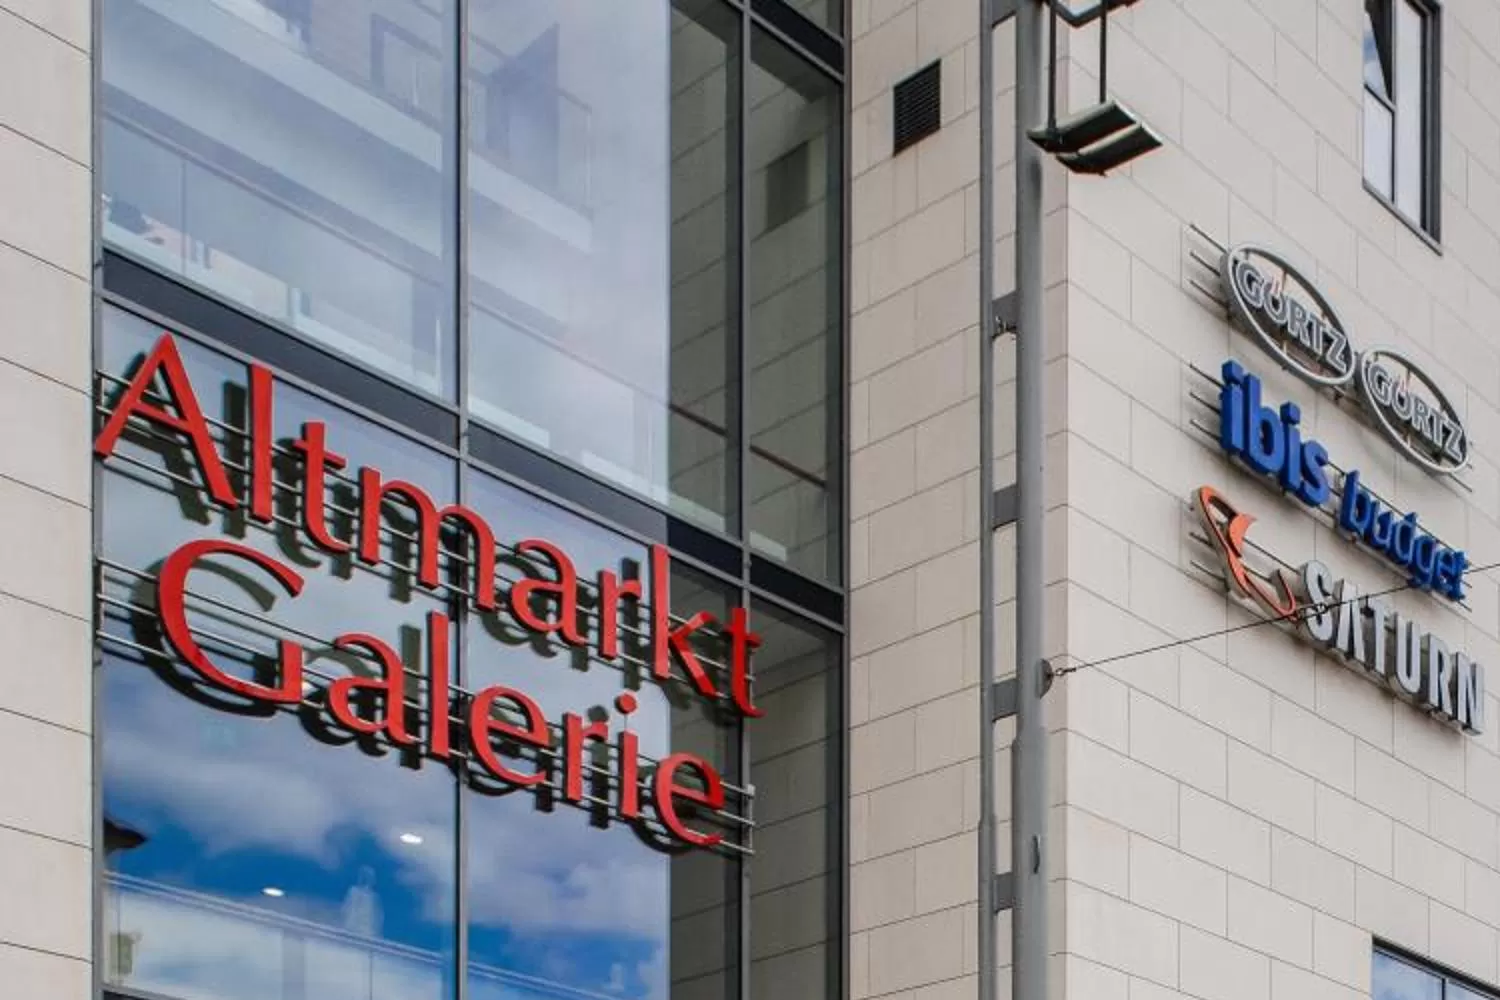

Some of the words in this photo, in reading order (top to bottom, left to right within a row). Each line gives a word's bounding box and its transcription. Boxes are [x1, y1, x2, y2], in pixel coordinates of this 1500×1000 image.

[1236, 259, 1347, 375] GÖRTZ
[1367, 363, 1463, 463] GÖRTZ
[93, 332, 764, 716] Altmarkt
[1219, 358, 1330, 507] ibis
[1340, 469, 1469, 601] budget
[156, 538, 725, 846] Galerie
[1299, 559, 1486, 736] SATURN
